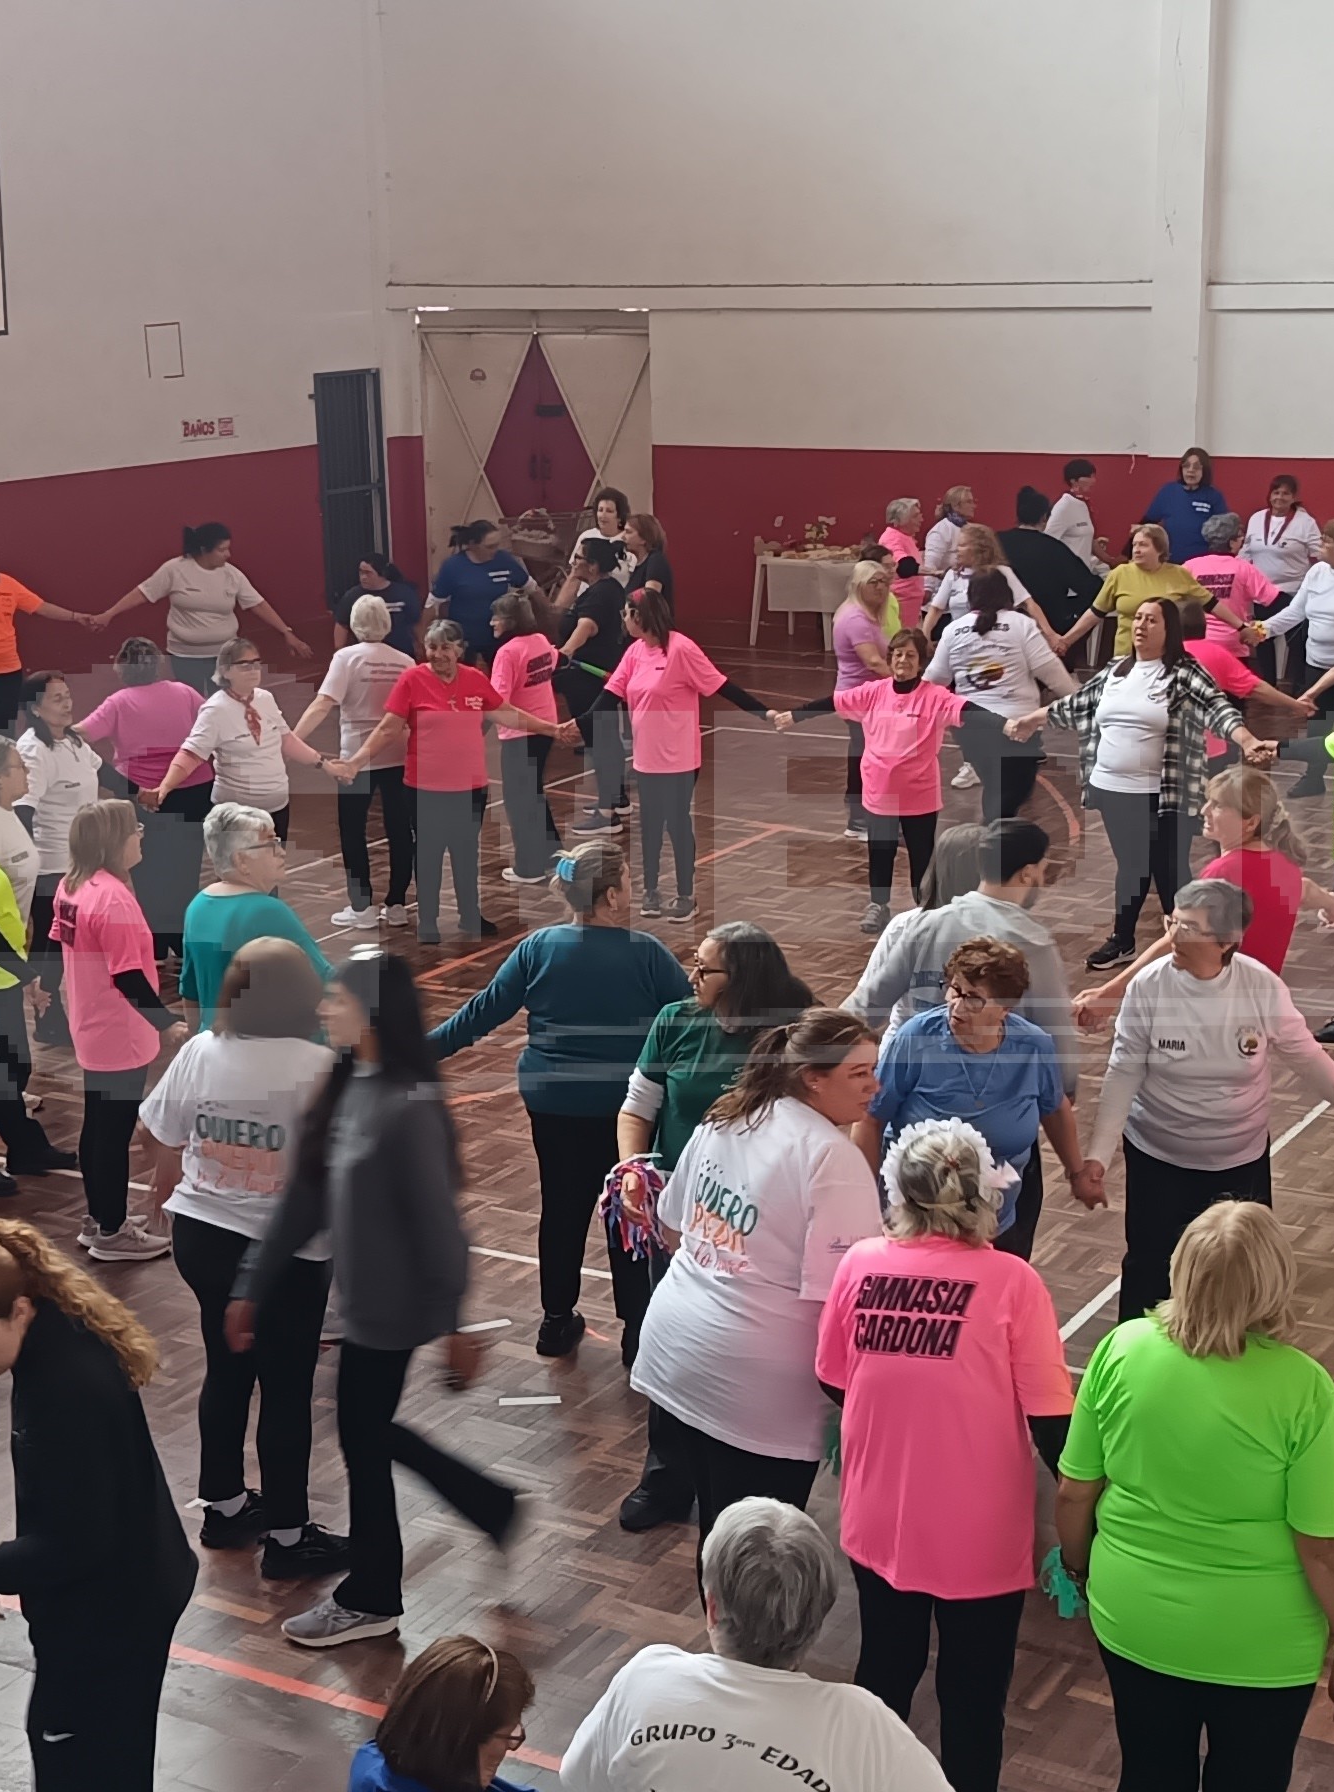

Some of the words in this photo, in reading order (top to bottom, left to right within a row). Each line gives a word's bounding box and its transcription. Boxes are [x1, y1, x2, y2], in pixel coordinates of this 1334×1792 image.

[1158, 1038, 1186, 1052] MARIA
[854, 1273, 978, 1318] GIMNASIA
[853, 1313, 964, 1359] CARDONA
[630, 1723, 716, 1746] GRUPO
[760, 1746, 832, 1792] EDAD
